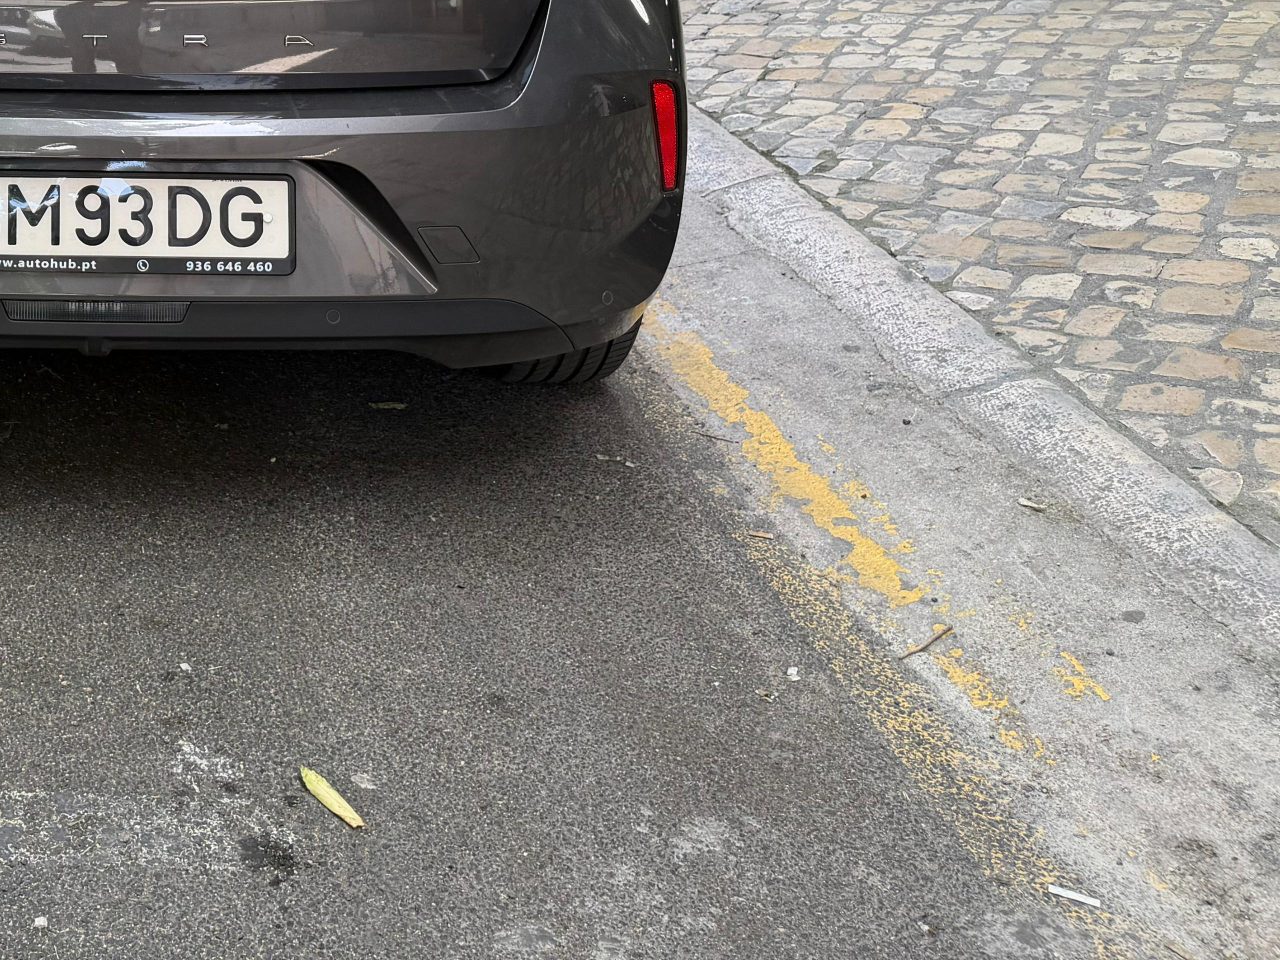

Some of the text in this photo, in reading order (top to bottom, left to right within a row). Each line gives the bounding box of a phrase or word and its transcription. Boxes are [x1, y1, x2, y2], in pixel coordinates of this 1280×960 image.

[185, 261, 273, 272] 936 646 460
